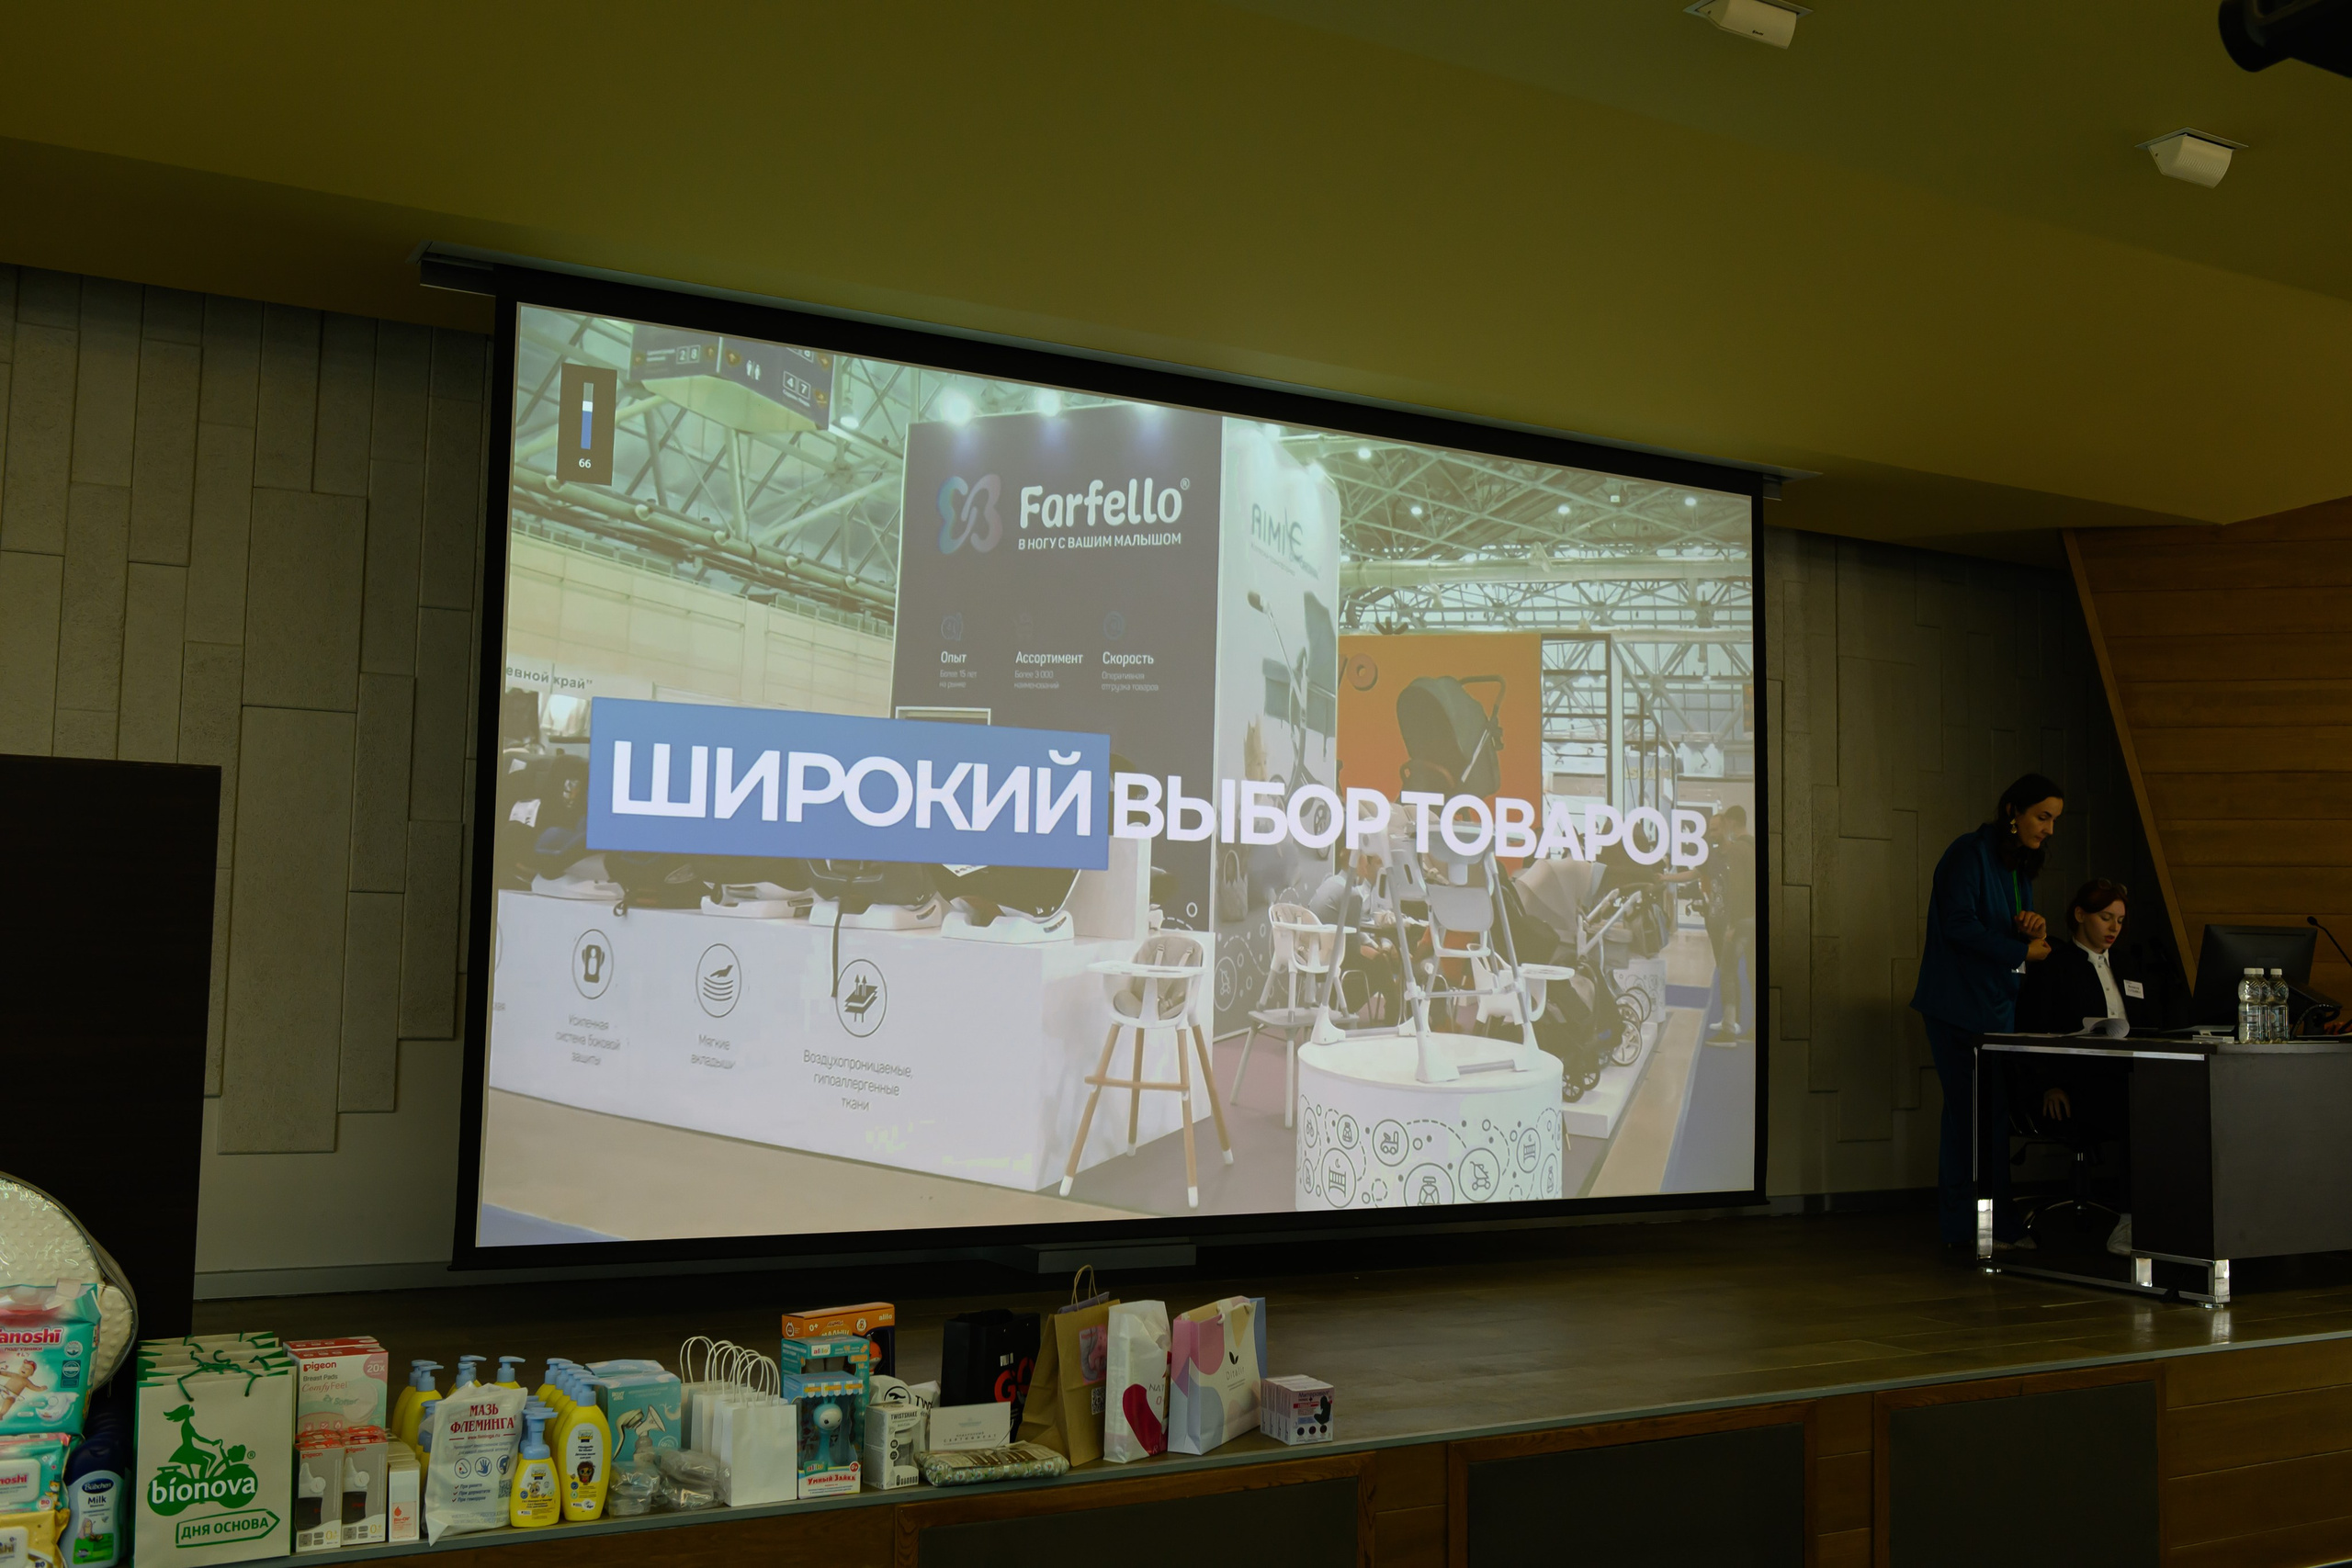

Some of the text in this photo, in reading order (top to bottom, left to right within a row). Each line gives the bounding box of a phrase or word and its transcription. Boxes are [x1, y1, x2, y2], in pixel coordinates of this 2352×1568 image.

[578, 458, 592, 468] 66
[1018, 533, 1182, 550] В НОГУ С ВАШИМ МАЛЫШОМ
[940, 650, 967, 664] Опыт
[1015, 650, 1083, 667] Ассортимент
[1102, 650, 1154, 668] Скорость
[611, 739, 1709, 867] ШИРОКИЙ ВЫБОР ТОВАРОВ
[697, 1033, 730, 1051] Мягкие
[803, 1048, 913, 1079] Воздухопроницаемые,
[813, 1071, 900, 1097] гипоаллергенные
[841, 1096, 870, 1111] ткани
[469, 1403, 499, 1417] МАЗЬ
[152, 1476, 256, 1505] bionova
[87, 1495, 107, 1505] Milk
[181, 1517, 269, 1540] ДНЯ ОСНОВА
